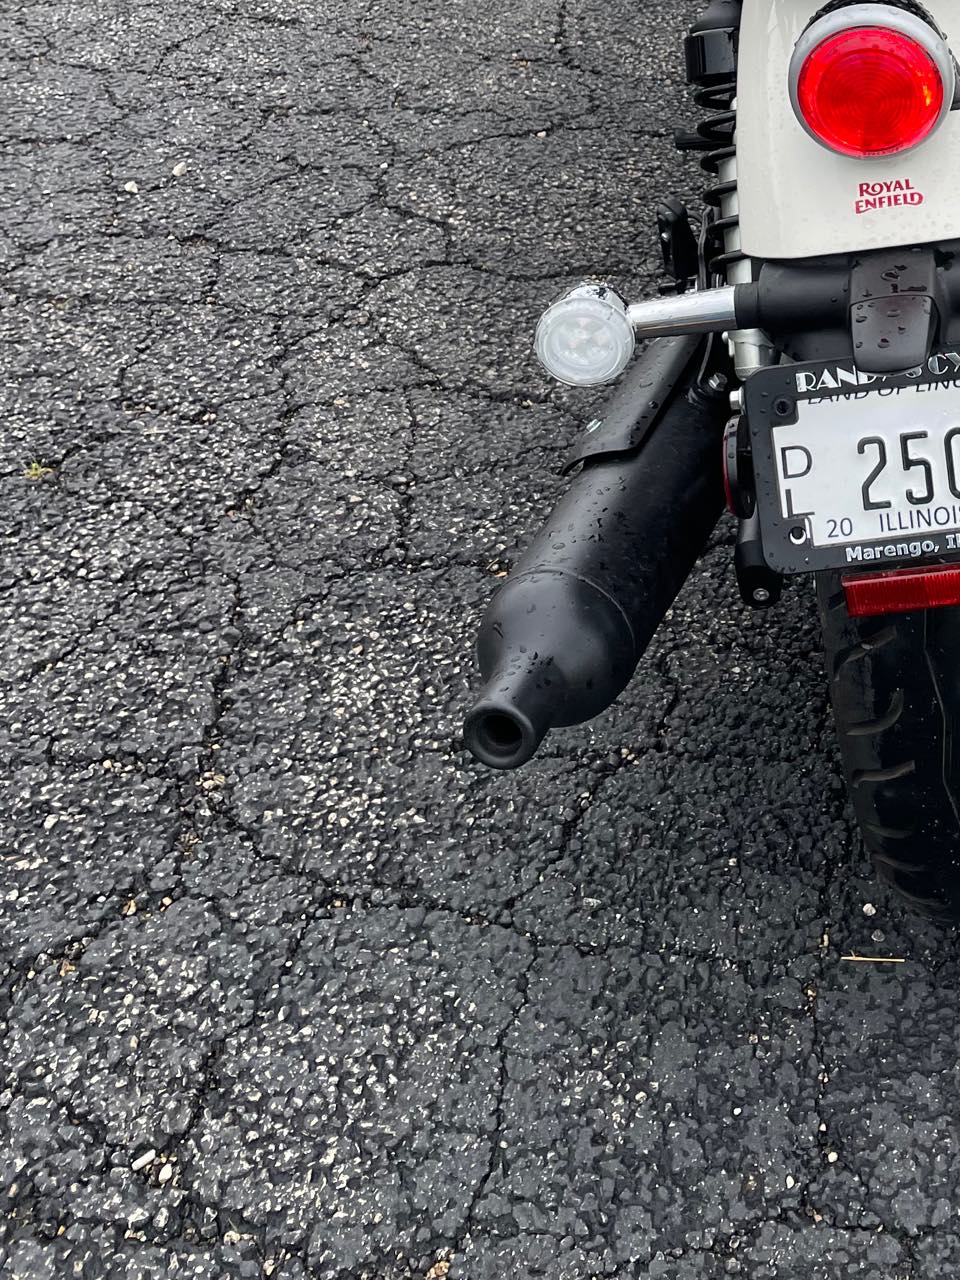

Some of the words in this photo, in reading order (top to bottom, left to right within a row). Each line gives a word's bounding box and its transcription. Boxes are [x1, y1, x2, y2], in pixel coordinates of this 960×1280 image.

[859, 178, 915, 197] ROYAL
[855, 192, 924, 214] ENFIELD
[826, 517, 853, 538] 20
[845, 538, 940, 562] Marengo,
